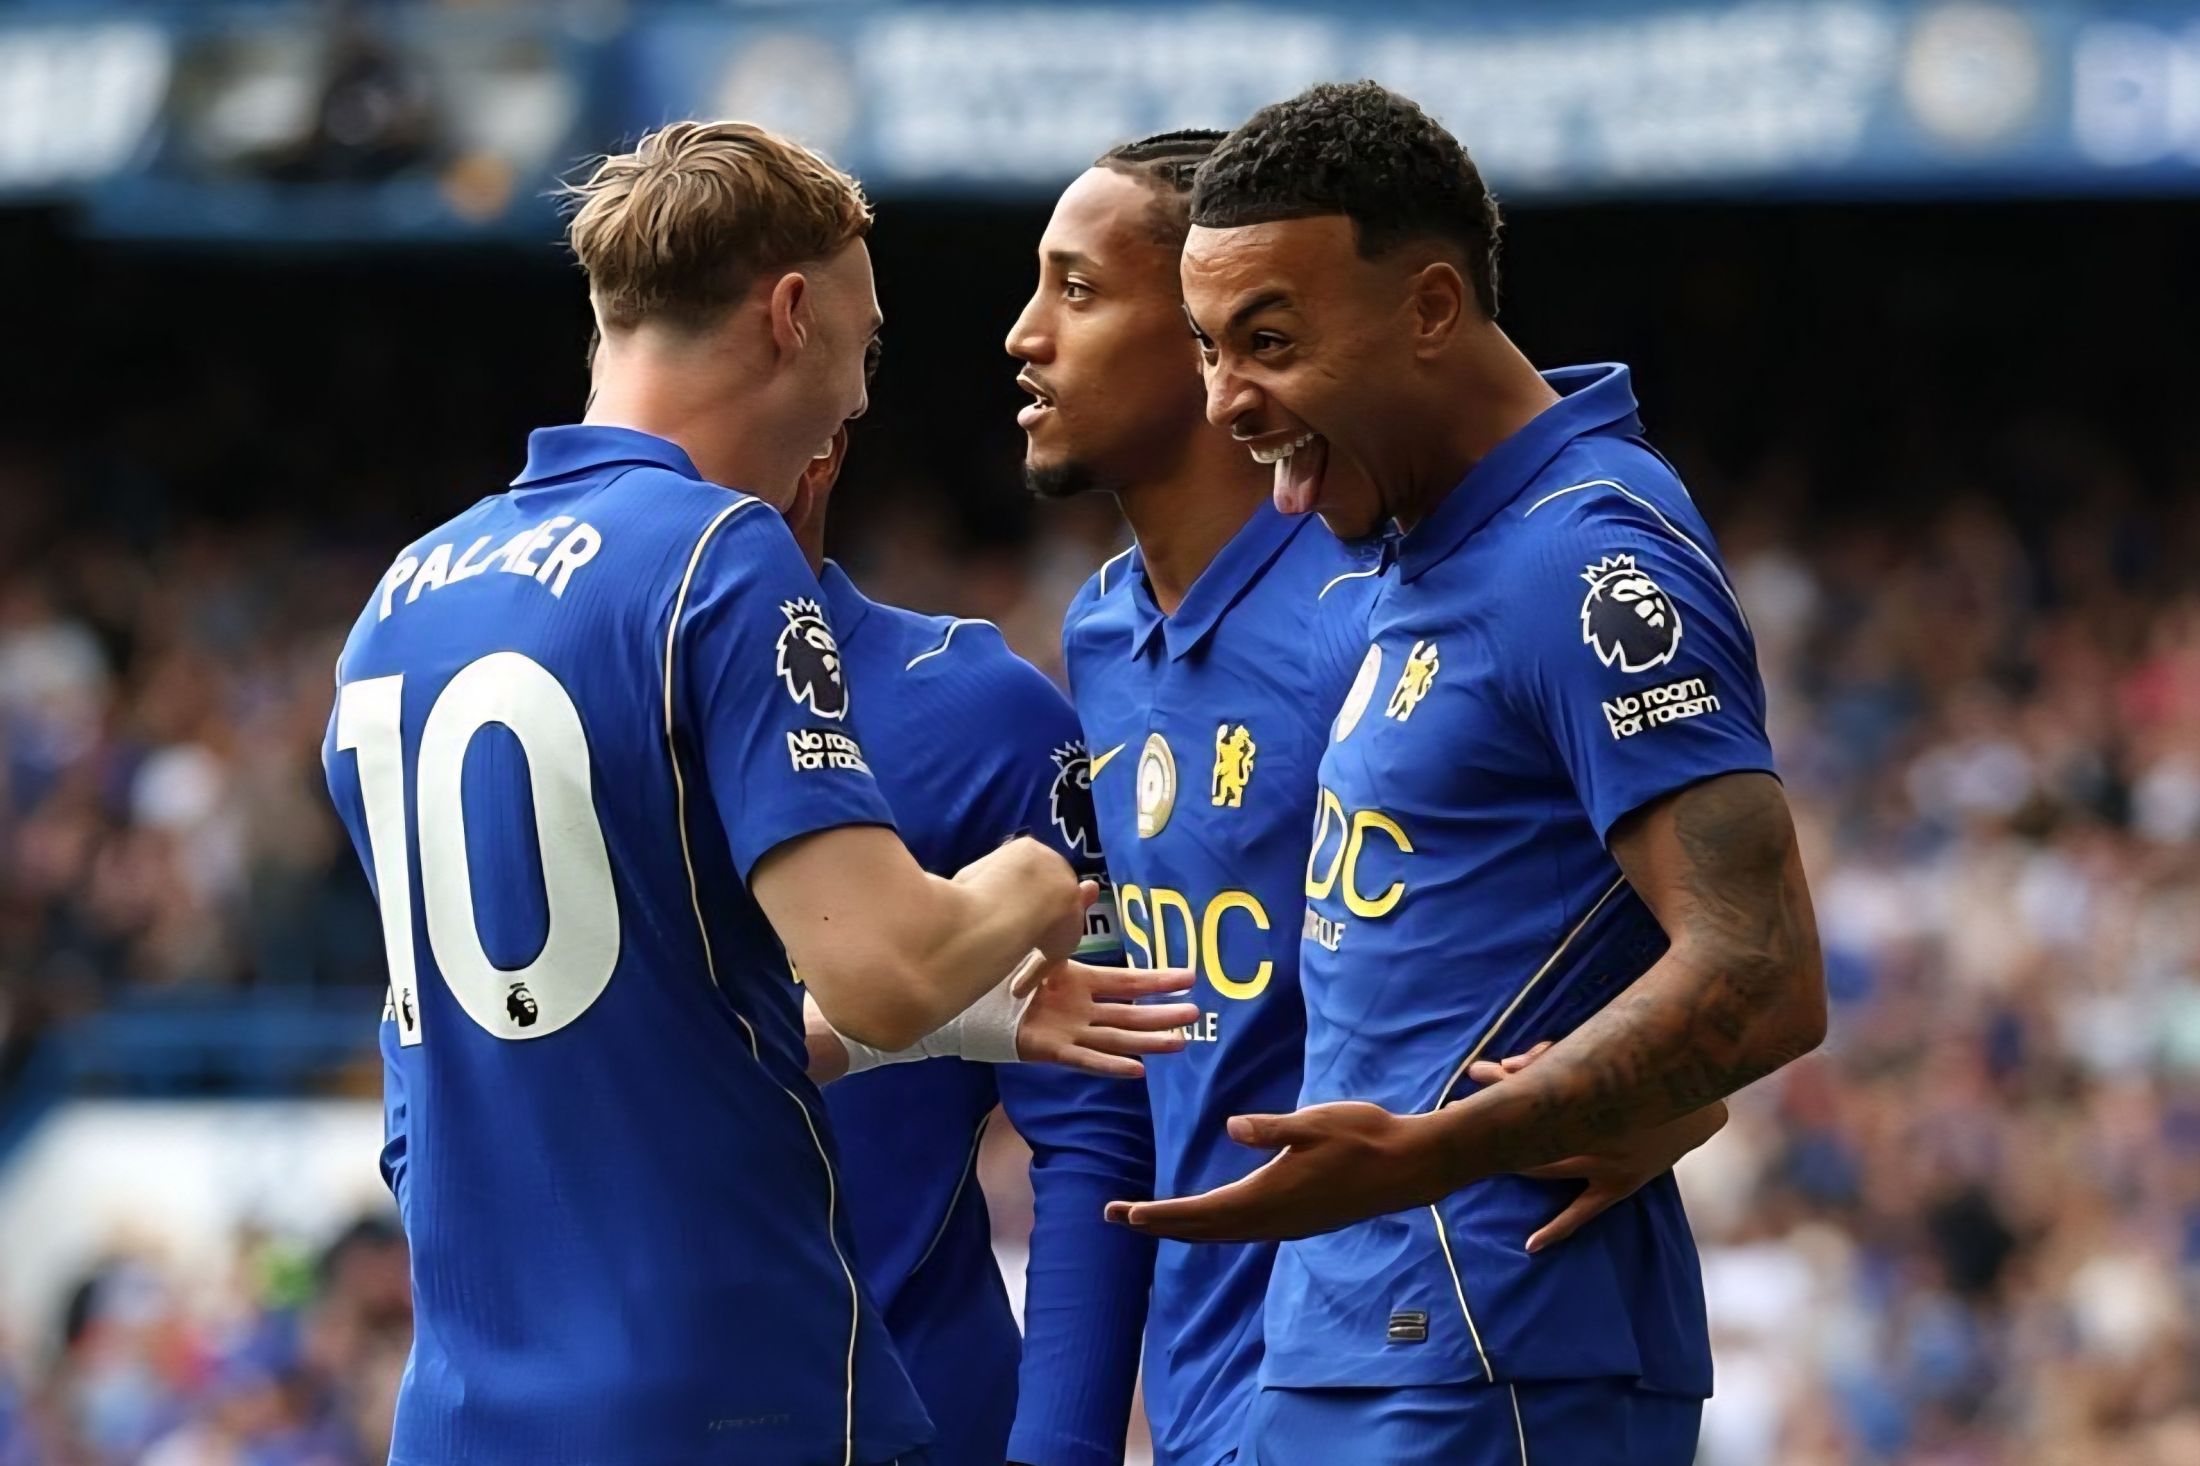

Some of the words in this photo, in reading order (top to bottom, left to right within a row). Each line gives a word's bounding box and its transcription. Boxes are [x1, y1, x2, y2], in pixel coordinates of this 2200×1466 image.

[786, 729, 823, 751] No
[1601, 696, 1640, 719] No
[1641, 677, 1706, 708] room
[337, 650, 621, 1047] 10
[1305, 786, 1414, 918] DC
[1112, 882, 1273, 1000] SDC
